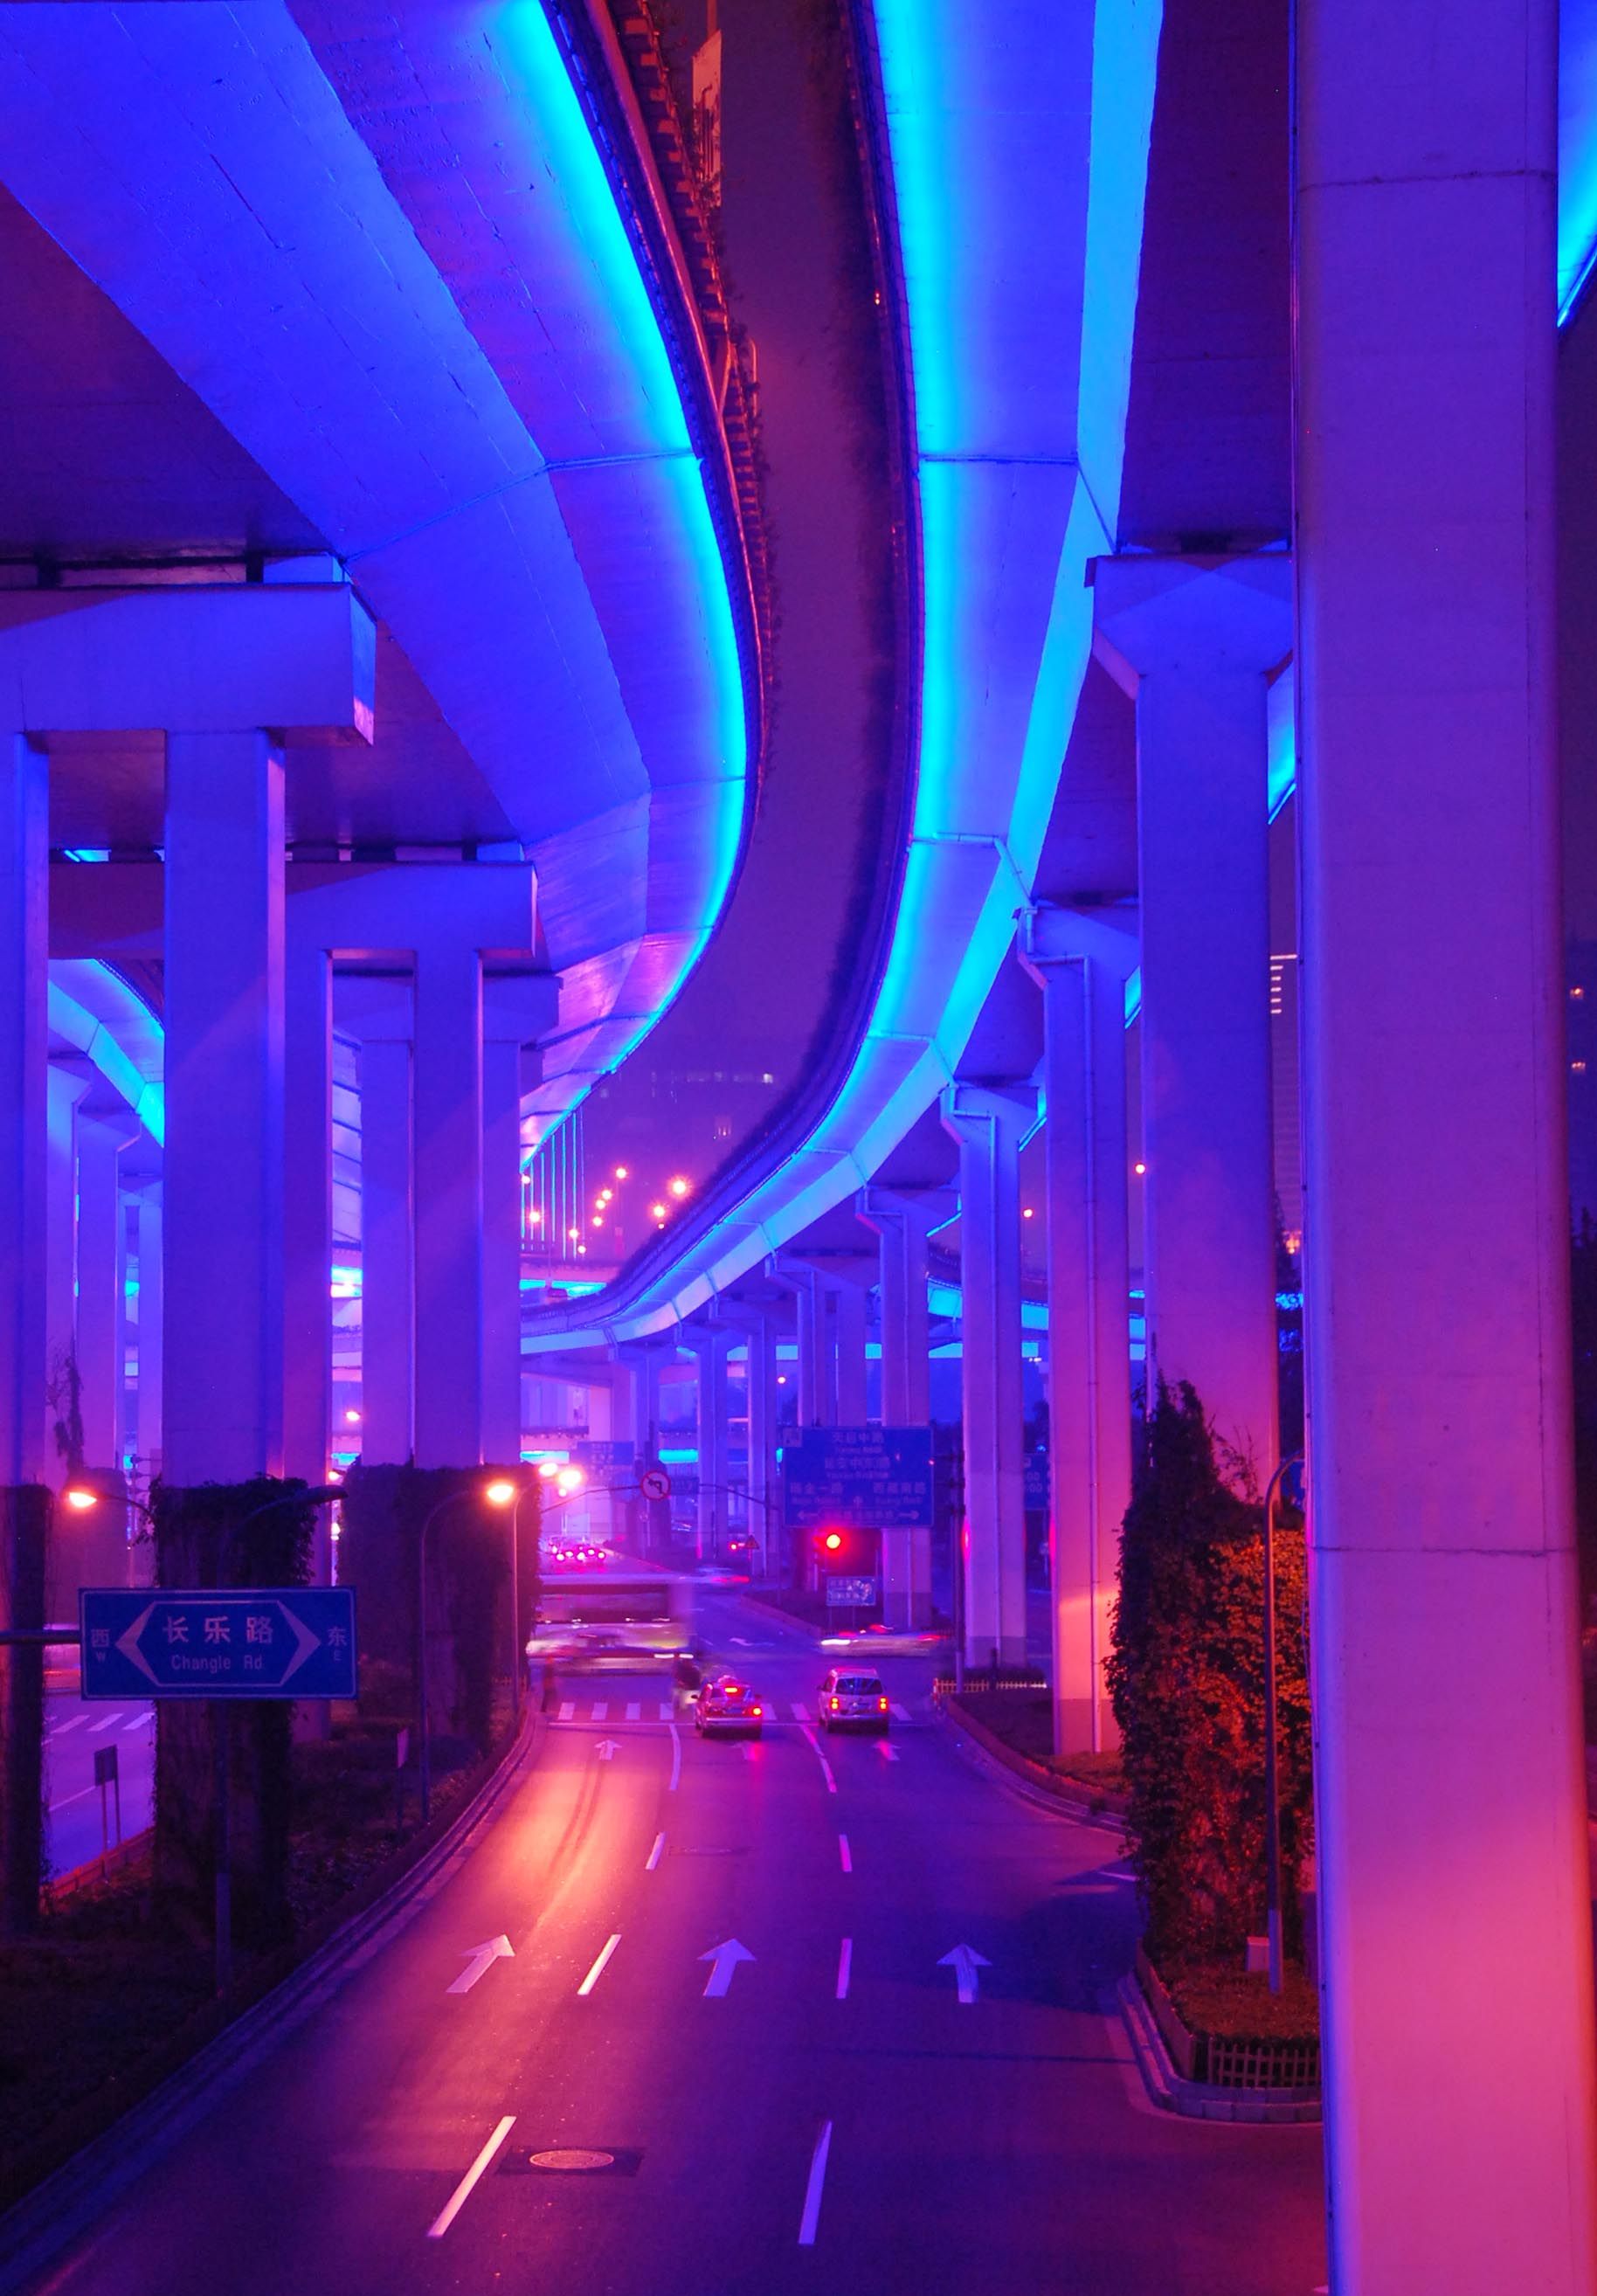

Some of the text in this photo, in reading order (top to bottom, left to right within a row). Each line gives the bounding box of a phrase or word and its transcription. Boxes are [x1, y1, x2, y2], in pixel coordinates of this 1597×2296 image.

[91, 1628, 111, 1649] 西
[163, 1615, 273, 1644] 长乐路
[328, 1626, 348, 1647] 东
[95, 1652, 107, 1663] W
[170, 1655, 232, 1674] Changle
[334, 1650, 342, 1663] E
